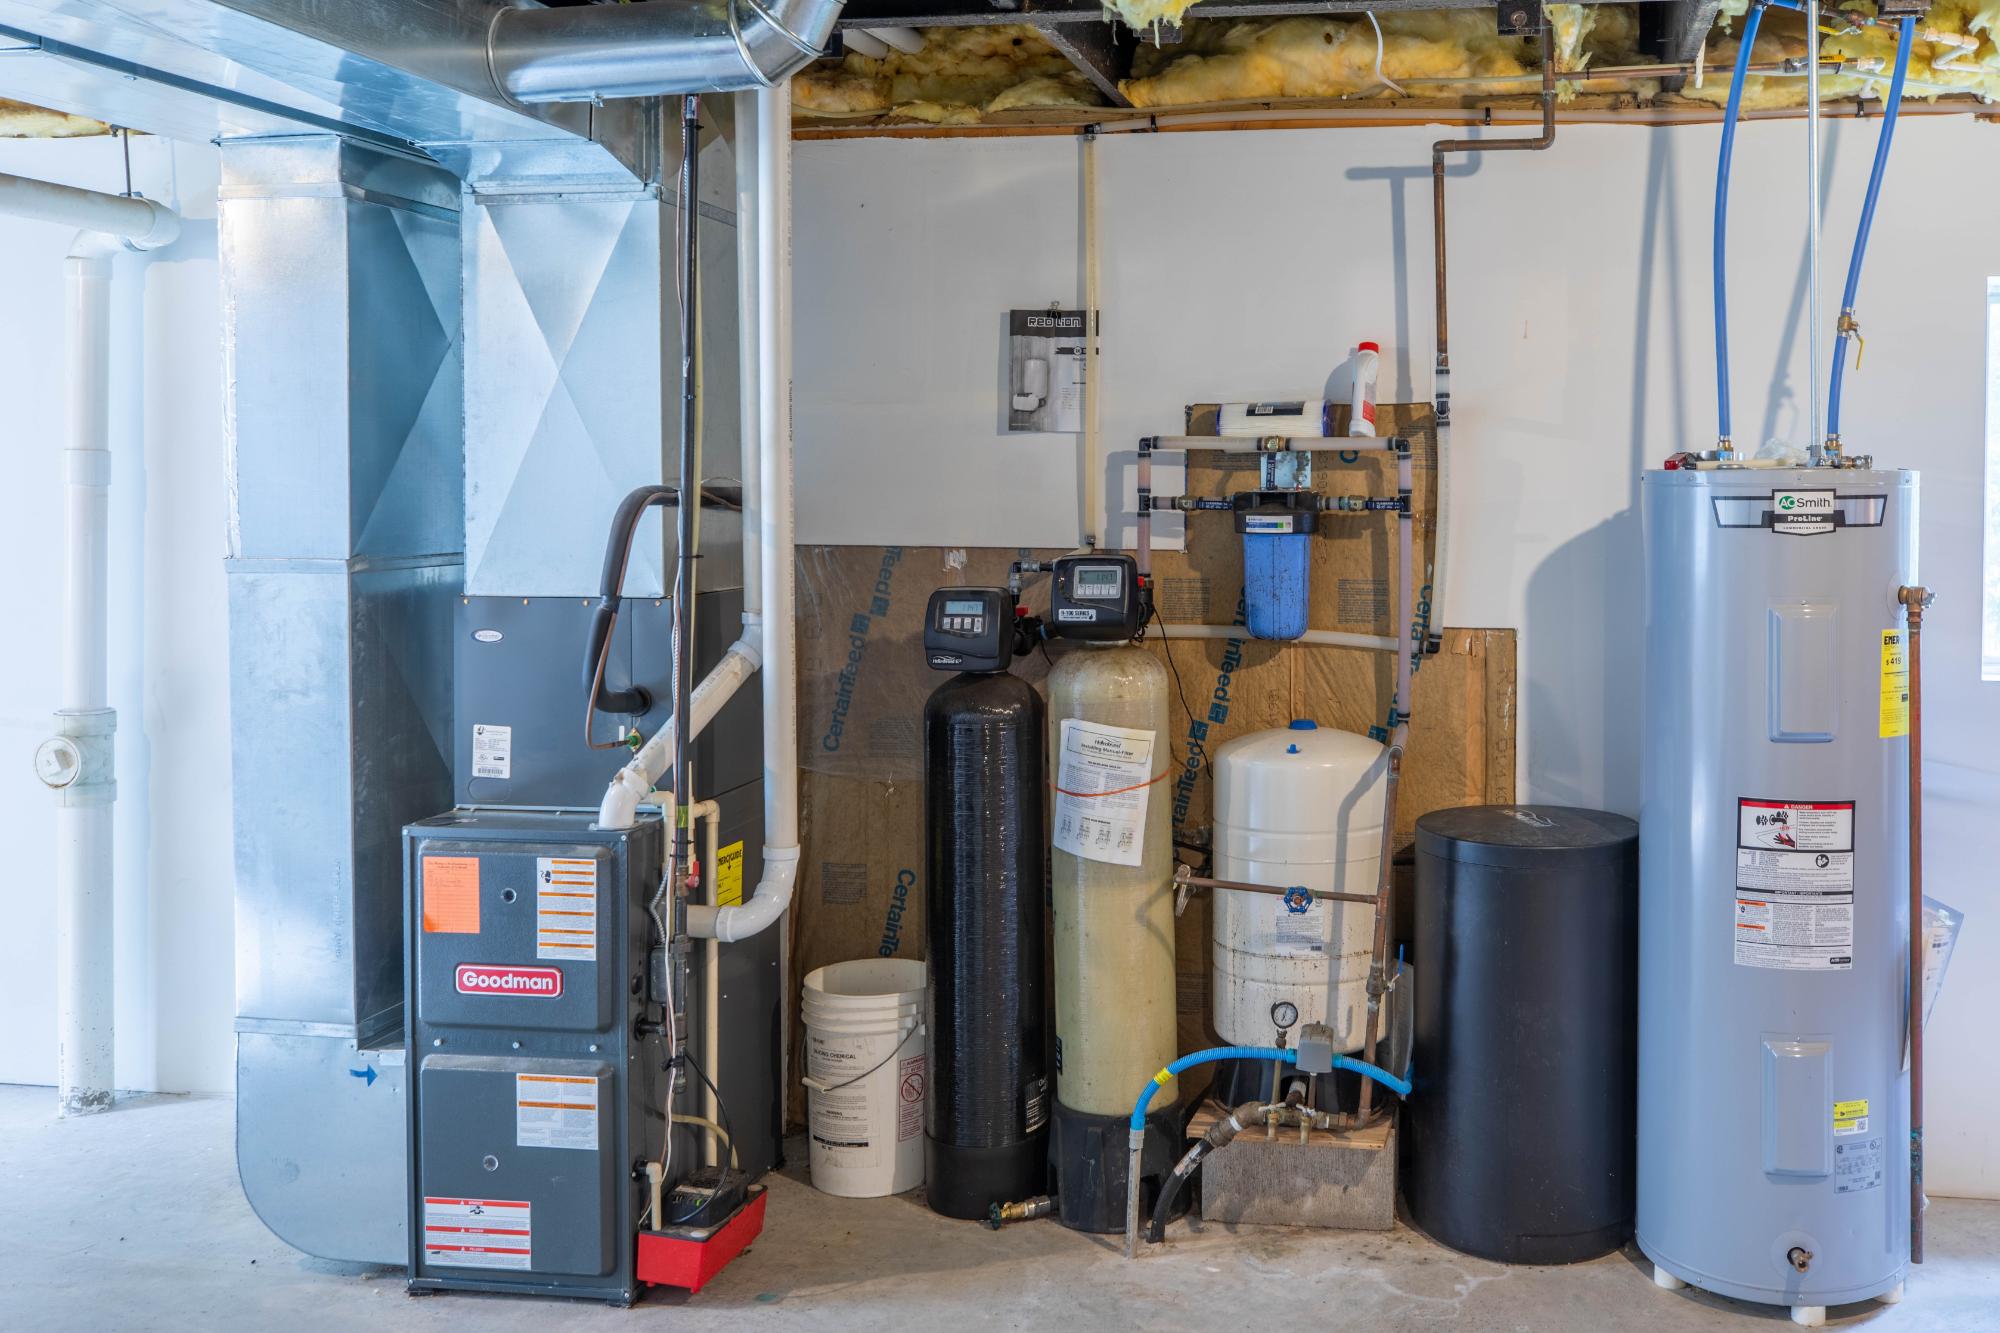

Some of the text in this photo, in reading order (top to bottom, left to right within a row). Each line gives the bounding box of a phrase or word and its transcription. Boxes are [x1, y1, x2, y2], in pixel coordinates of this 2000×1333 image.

[1055, 316, 1082, 328] LION
[822, 635, 866, 752] CertainTeed
[462, 970, 553, 991] Goodman
